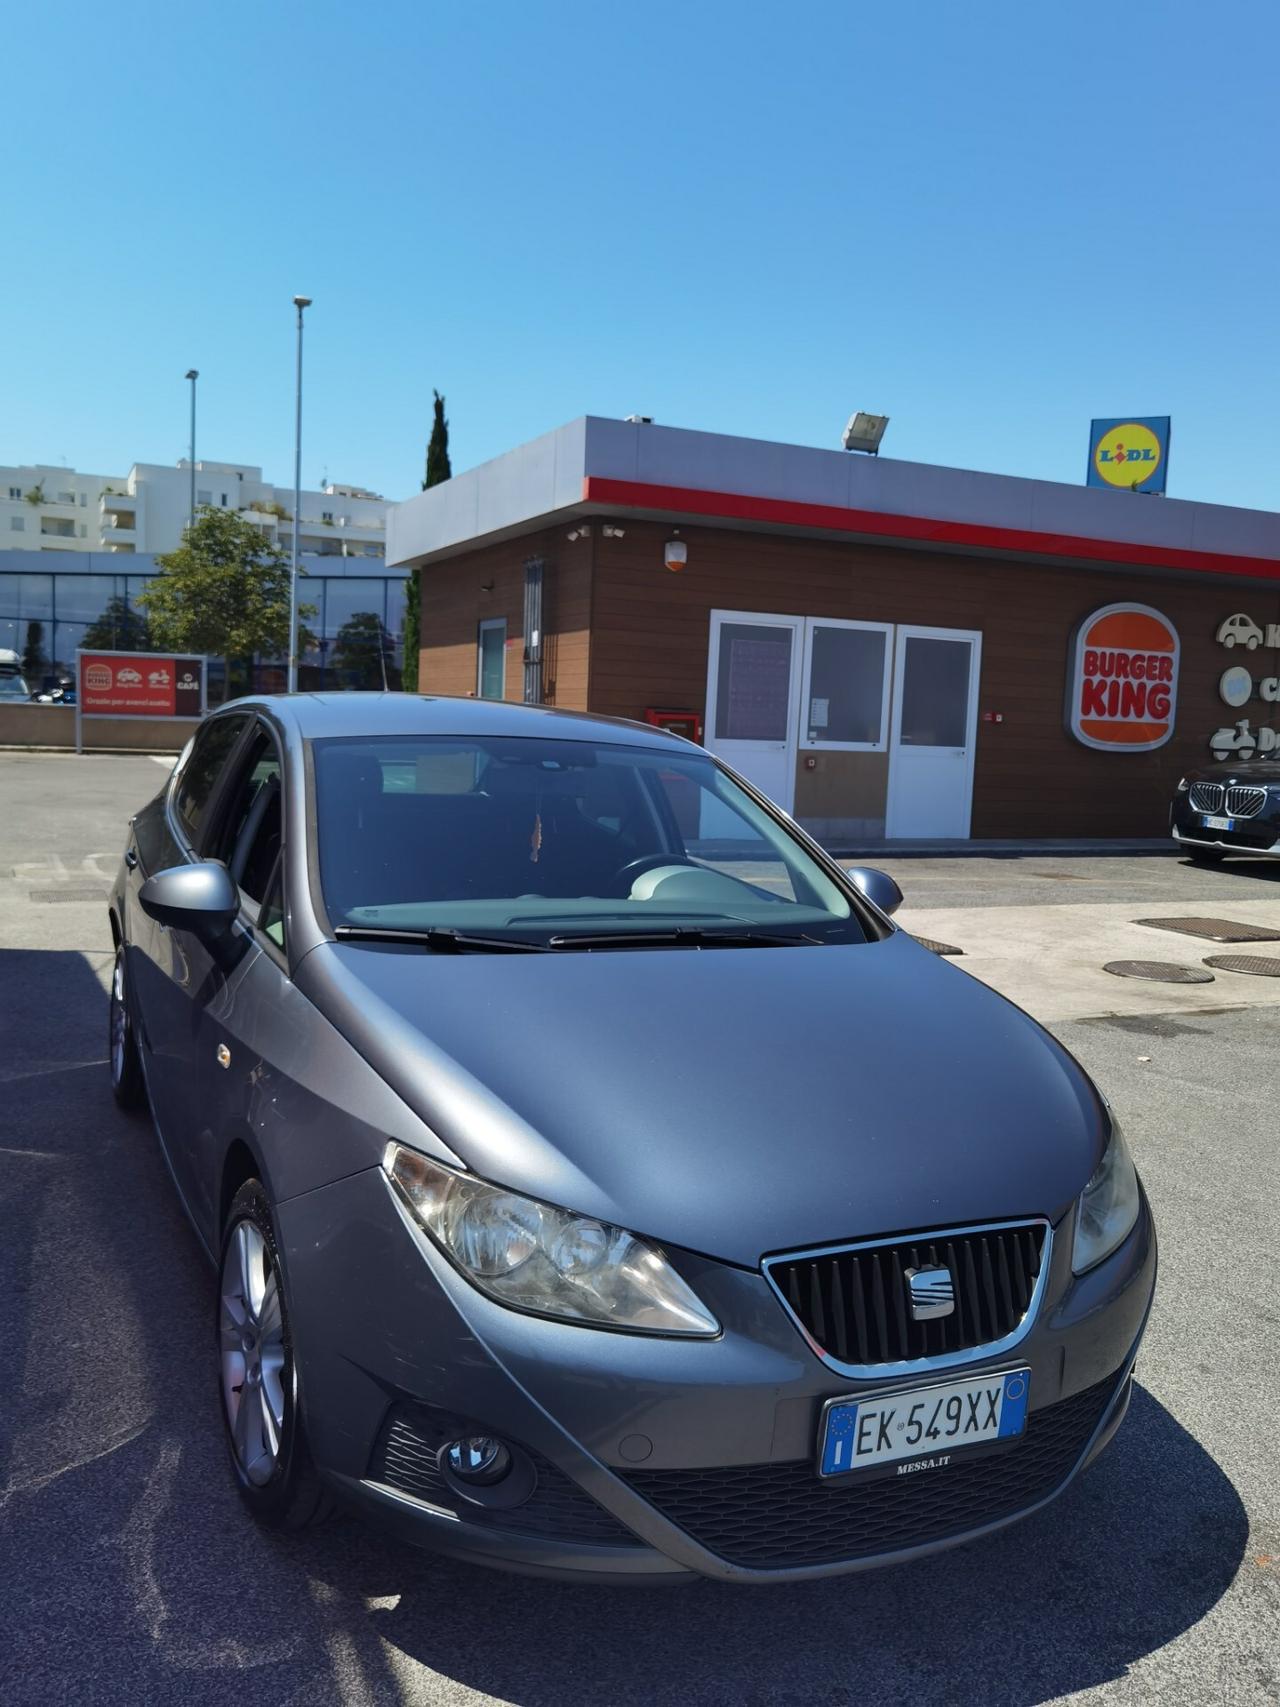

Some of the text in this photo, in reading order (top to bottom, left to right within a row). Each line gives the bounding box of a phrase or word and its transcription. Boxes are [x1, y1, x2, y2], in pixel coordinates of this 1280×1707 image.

[1084, 650, 1173, 682] BURGER
[1081, 678, 1171, 720] KING
[856, 1387, 1001, 1456] EK 549XX
[896, 1455, 951, 1476] MESSA.IT
